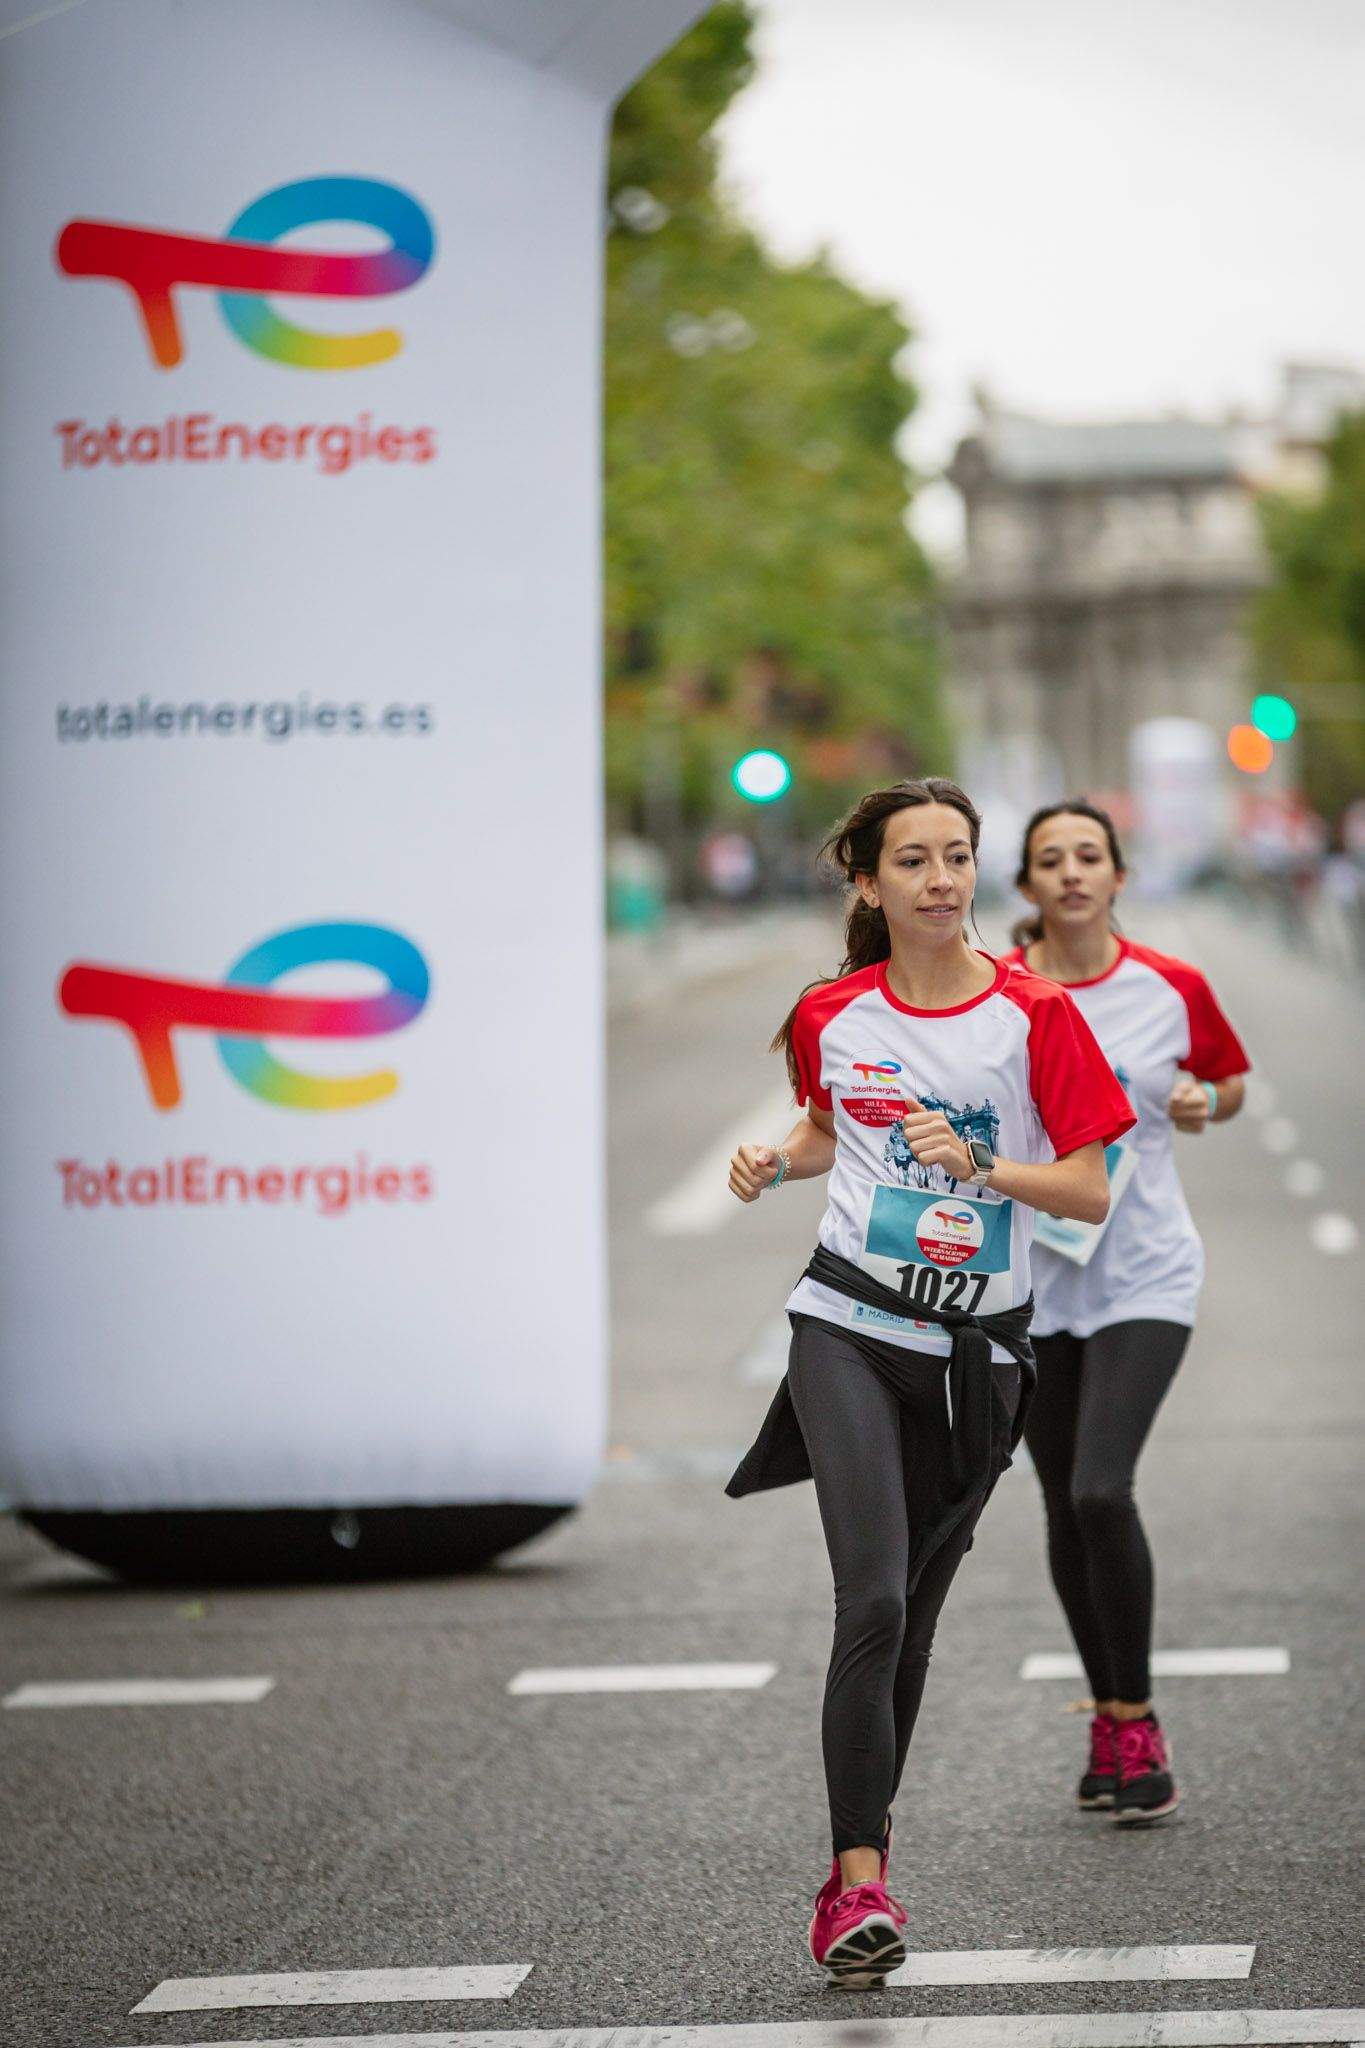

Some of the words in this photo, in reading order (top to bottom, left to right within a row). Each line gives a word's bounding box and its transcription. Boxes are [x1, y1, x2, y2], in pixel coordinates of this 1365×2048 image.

[56, 413, 437, 474] TotalEnergies
[56, 694, 433, 743] totalenergies.es
[851, 1086, 901, 1095] TotalEnergies
[56, 1153, 432, 1215] TotalEnergies
[896, 1264, 990, 1313] 1027
[868, 1310, 905, 1324] MADRID
